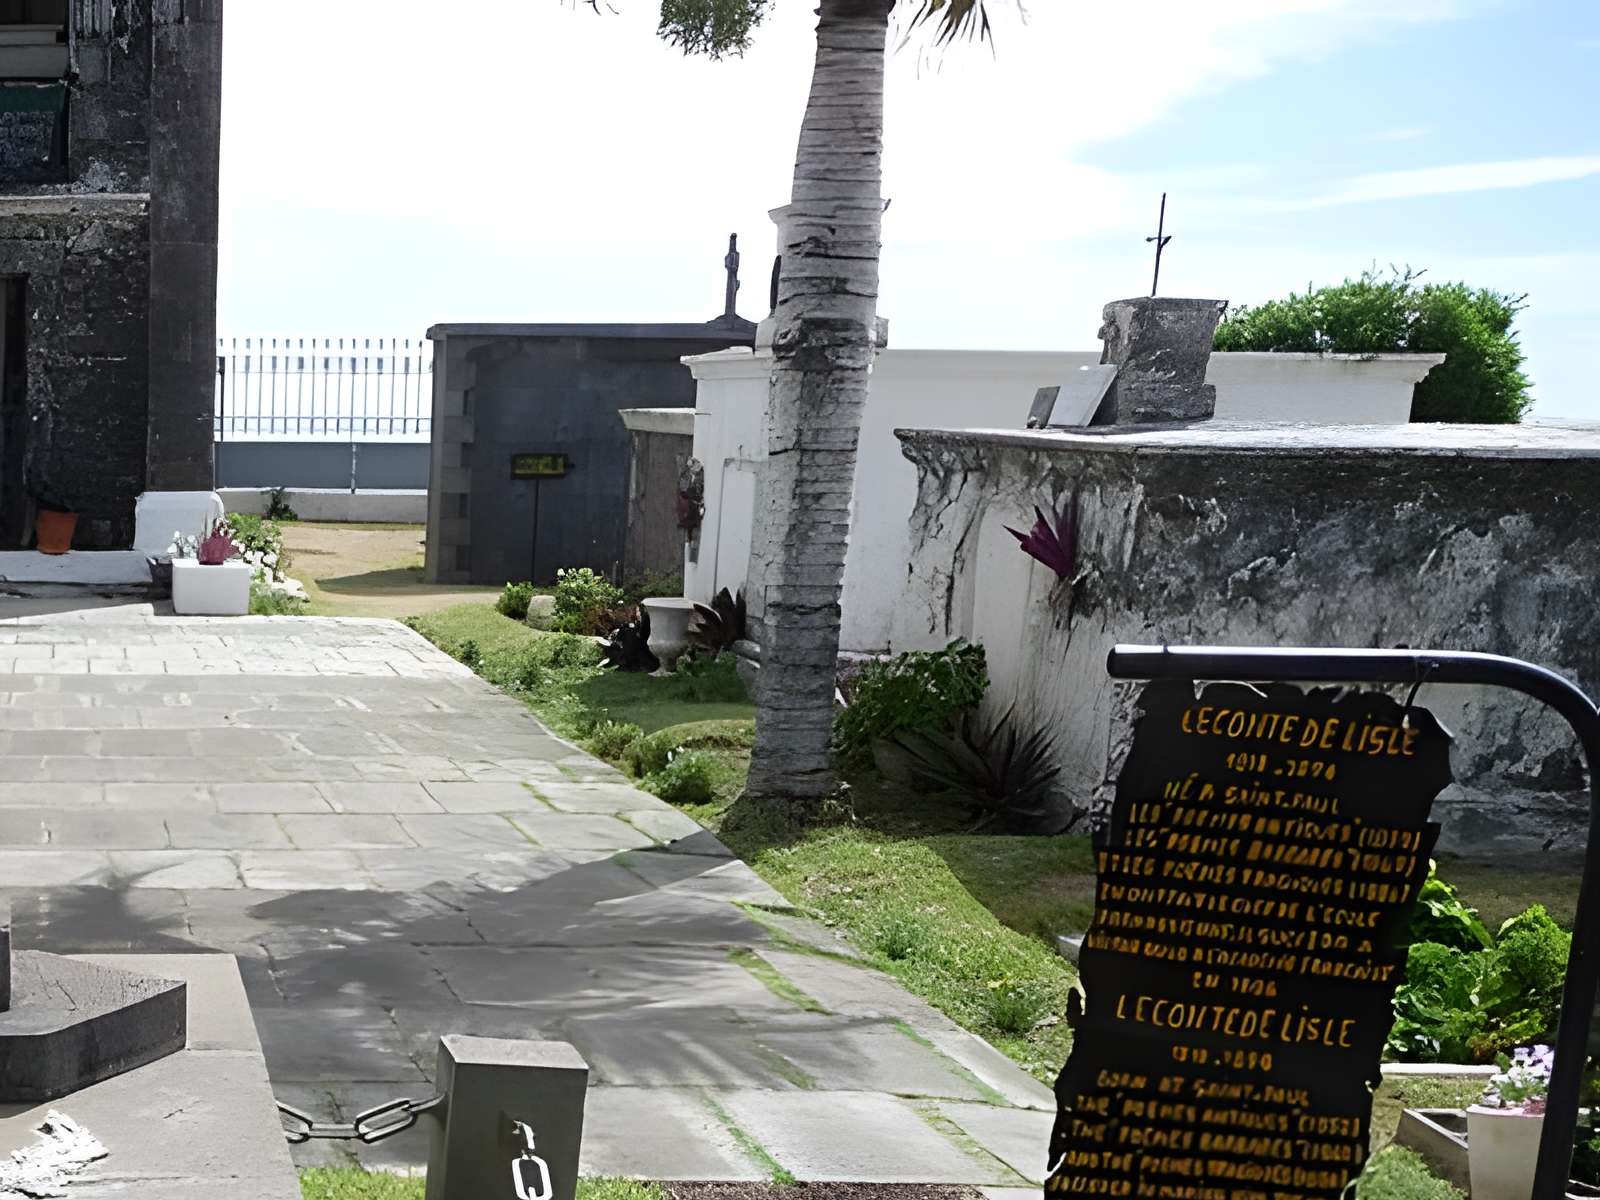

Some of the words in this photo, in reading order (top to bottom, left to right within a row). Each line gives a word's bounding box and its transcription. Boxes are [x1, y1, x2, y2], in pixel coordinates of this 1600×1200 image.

[1299, 718, 1339, 749] DE
[1116, 994, 1240, 1035] LECONTE
[1239, 1009, 1276, 1039] DE
[1280, 1005, 1356, 1048] LISLE
